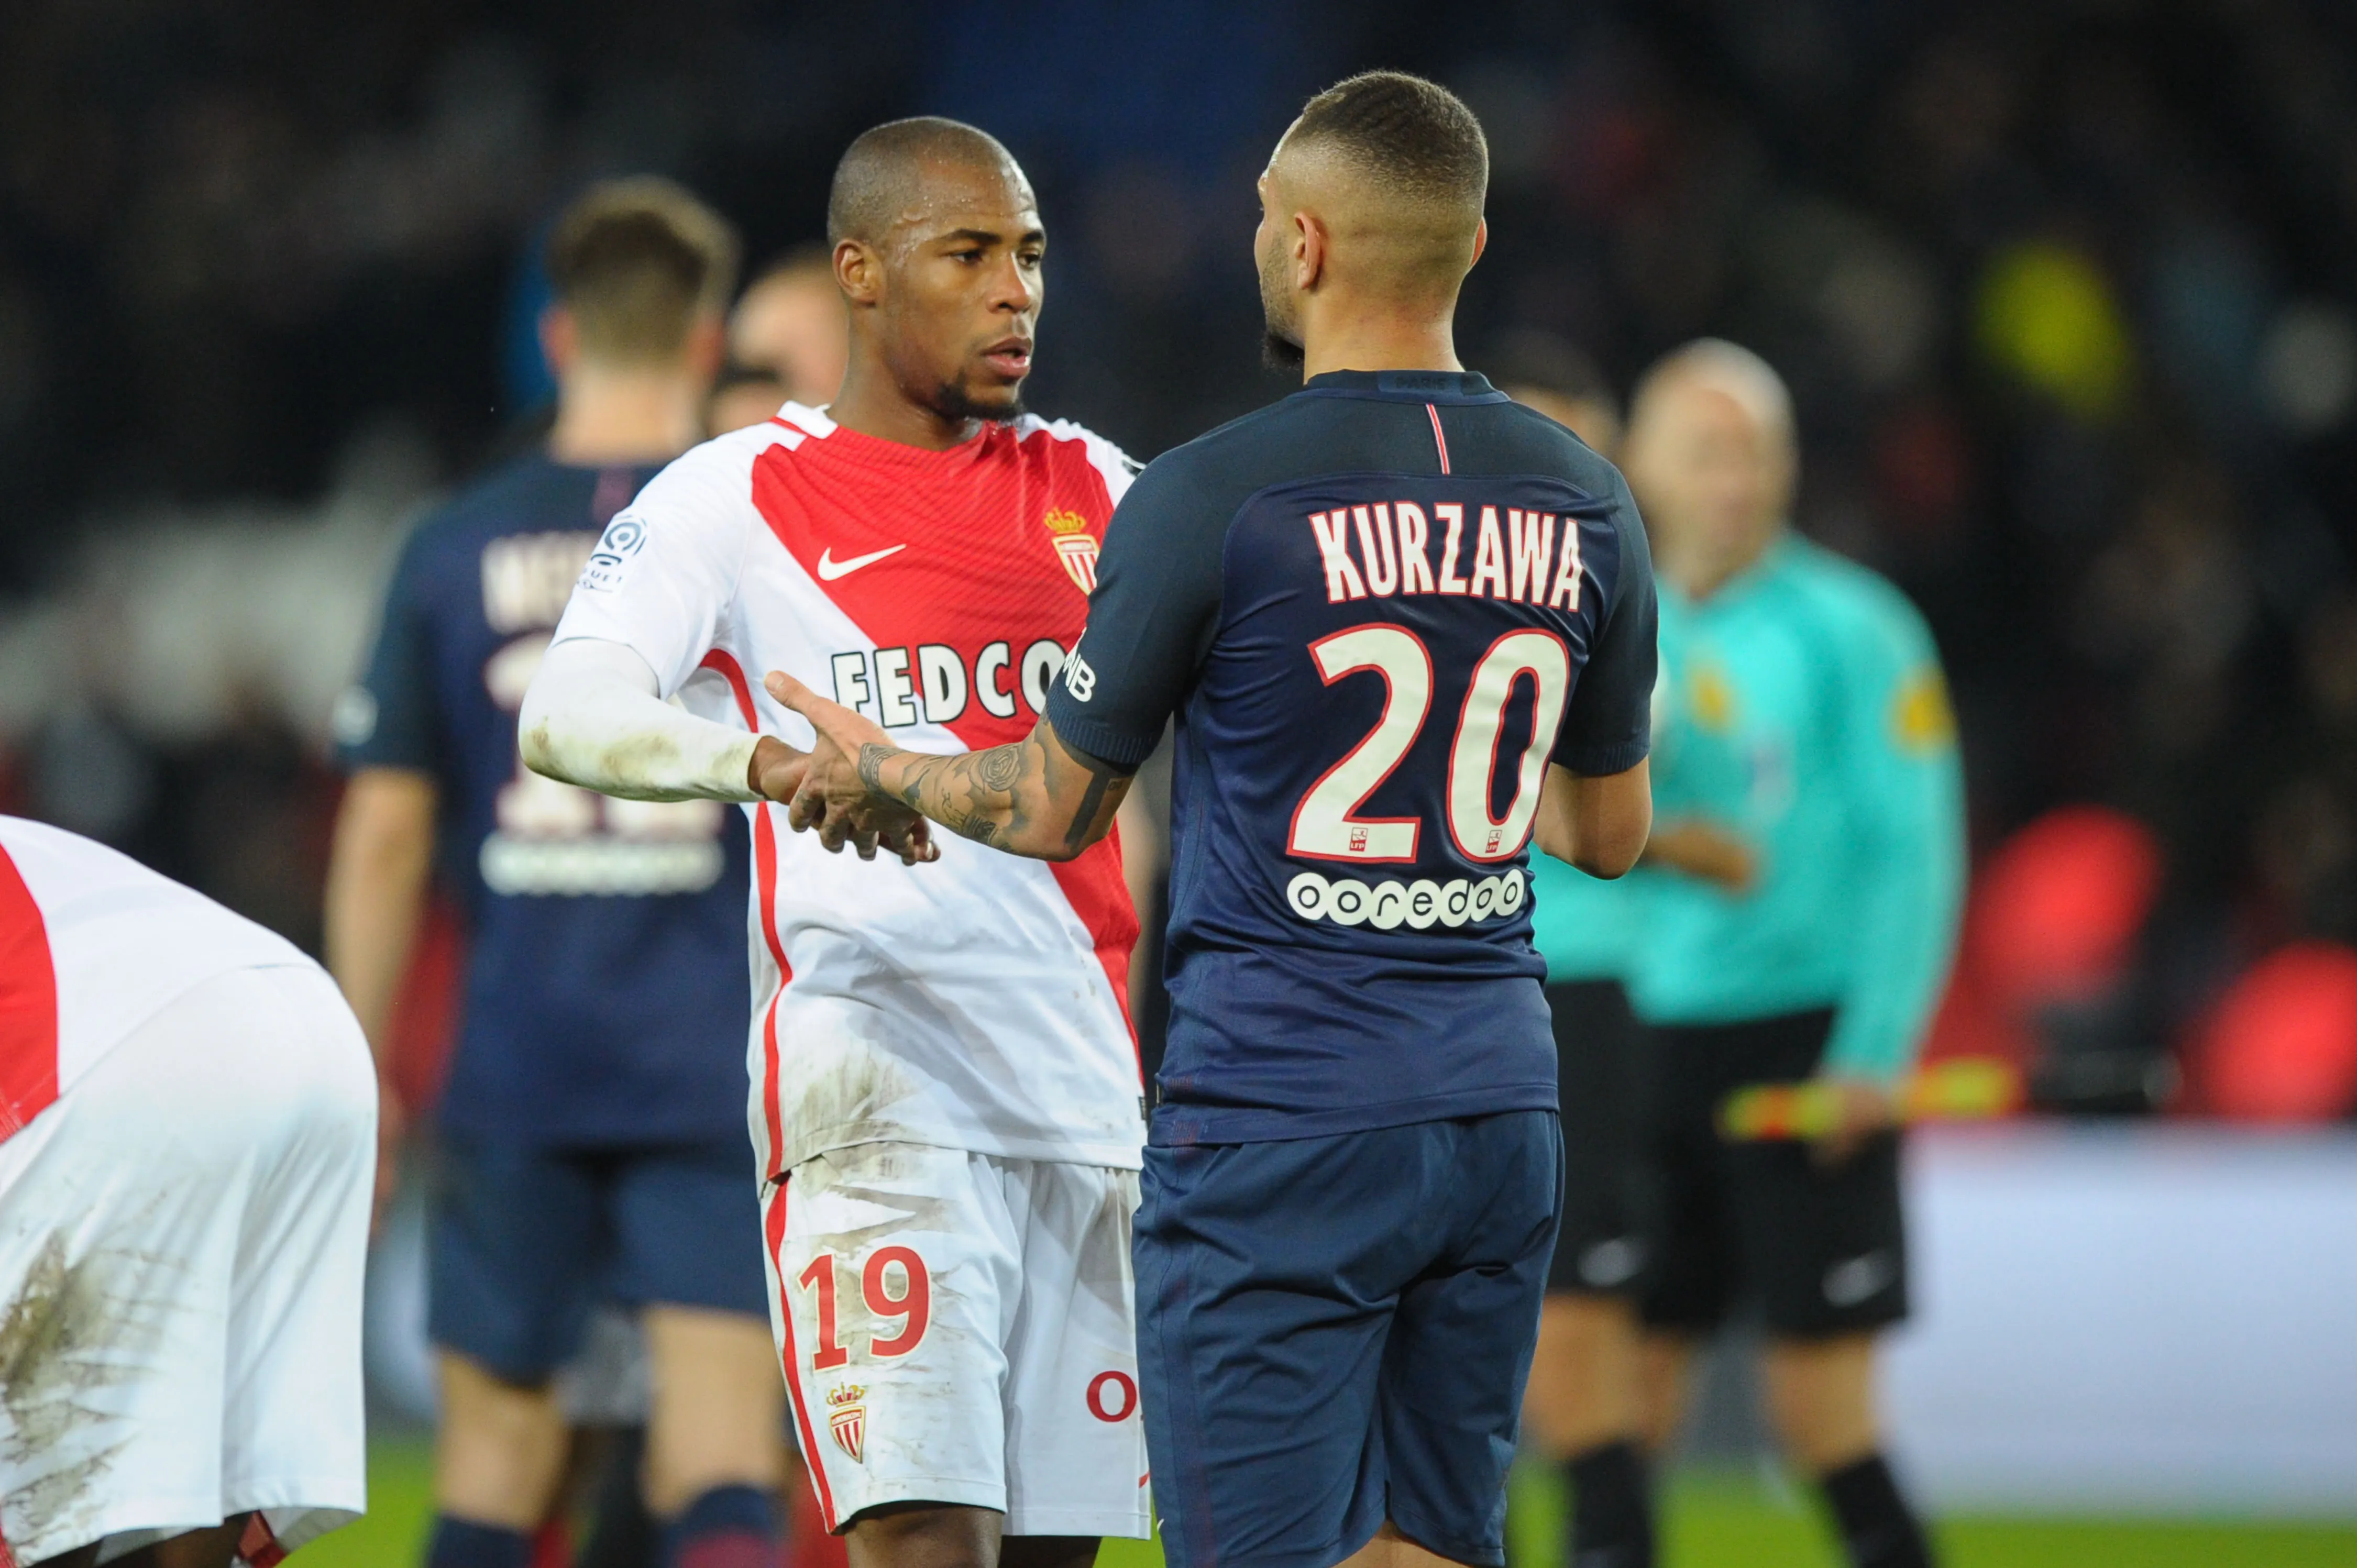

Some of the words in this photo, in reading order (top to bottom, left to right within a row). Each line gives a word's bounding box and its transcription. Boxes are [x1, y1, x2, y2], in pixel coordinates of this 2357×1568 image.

[1309, 501, 1583, 612] KURZAWA
[831, 639, 1066, 728] FEDCO
[1286, 621, 1569, 864] 20
[1296, 879, 1519, 918] ooredoo
[797, 1244, 932, 1373] 19
[1086, 1370, 1139, 1423] O
